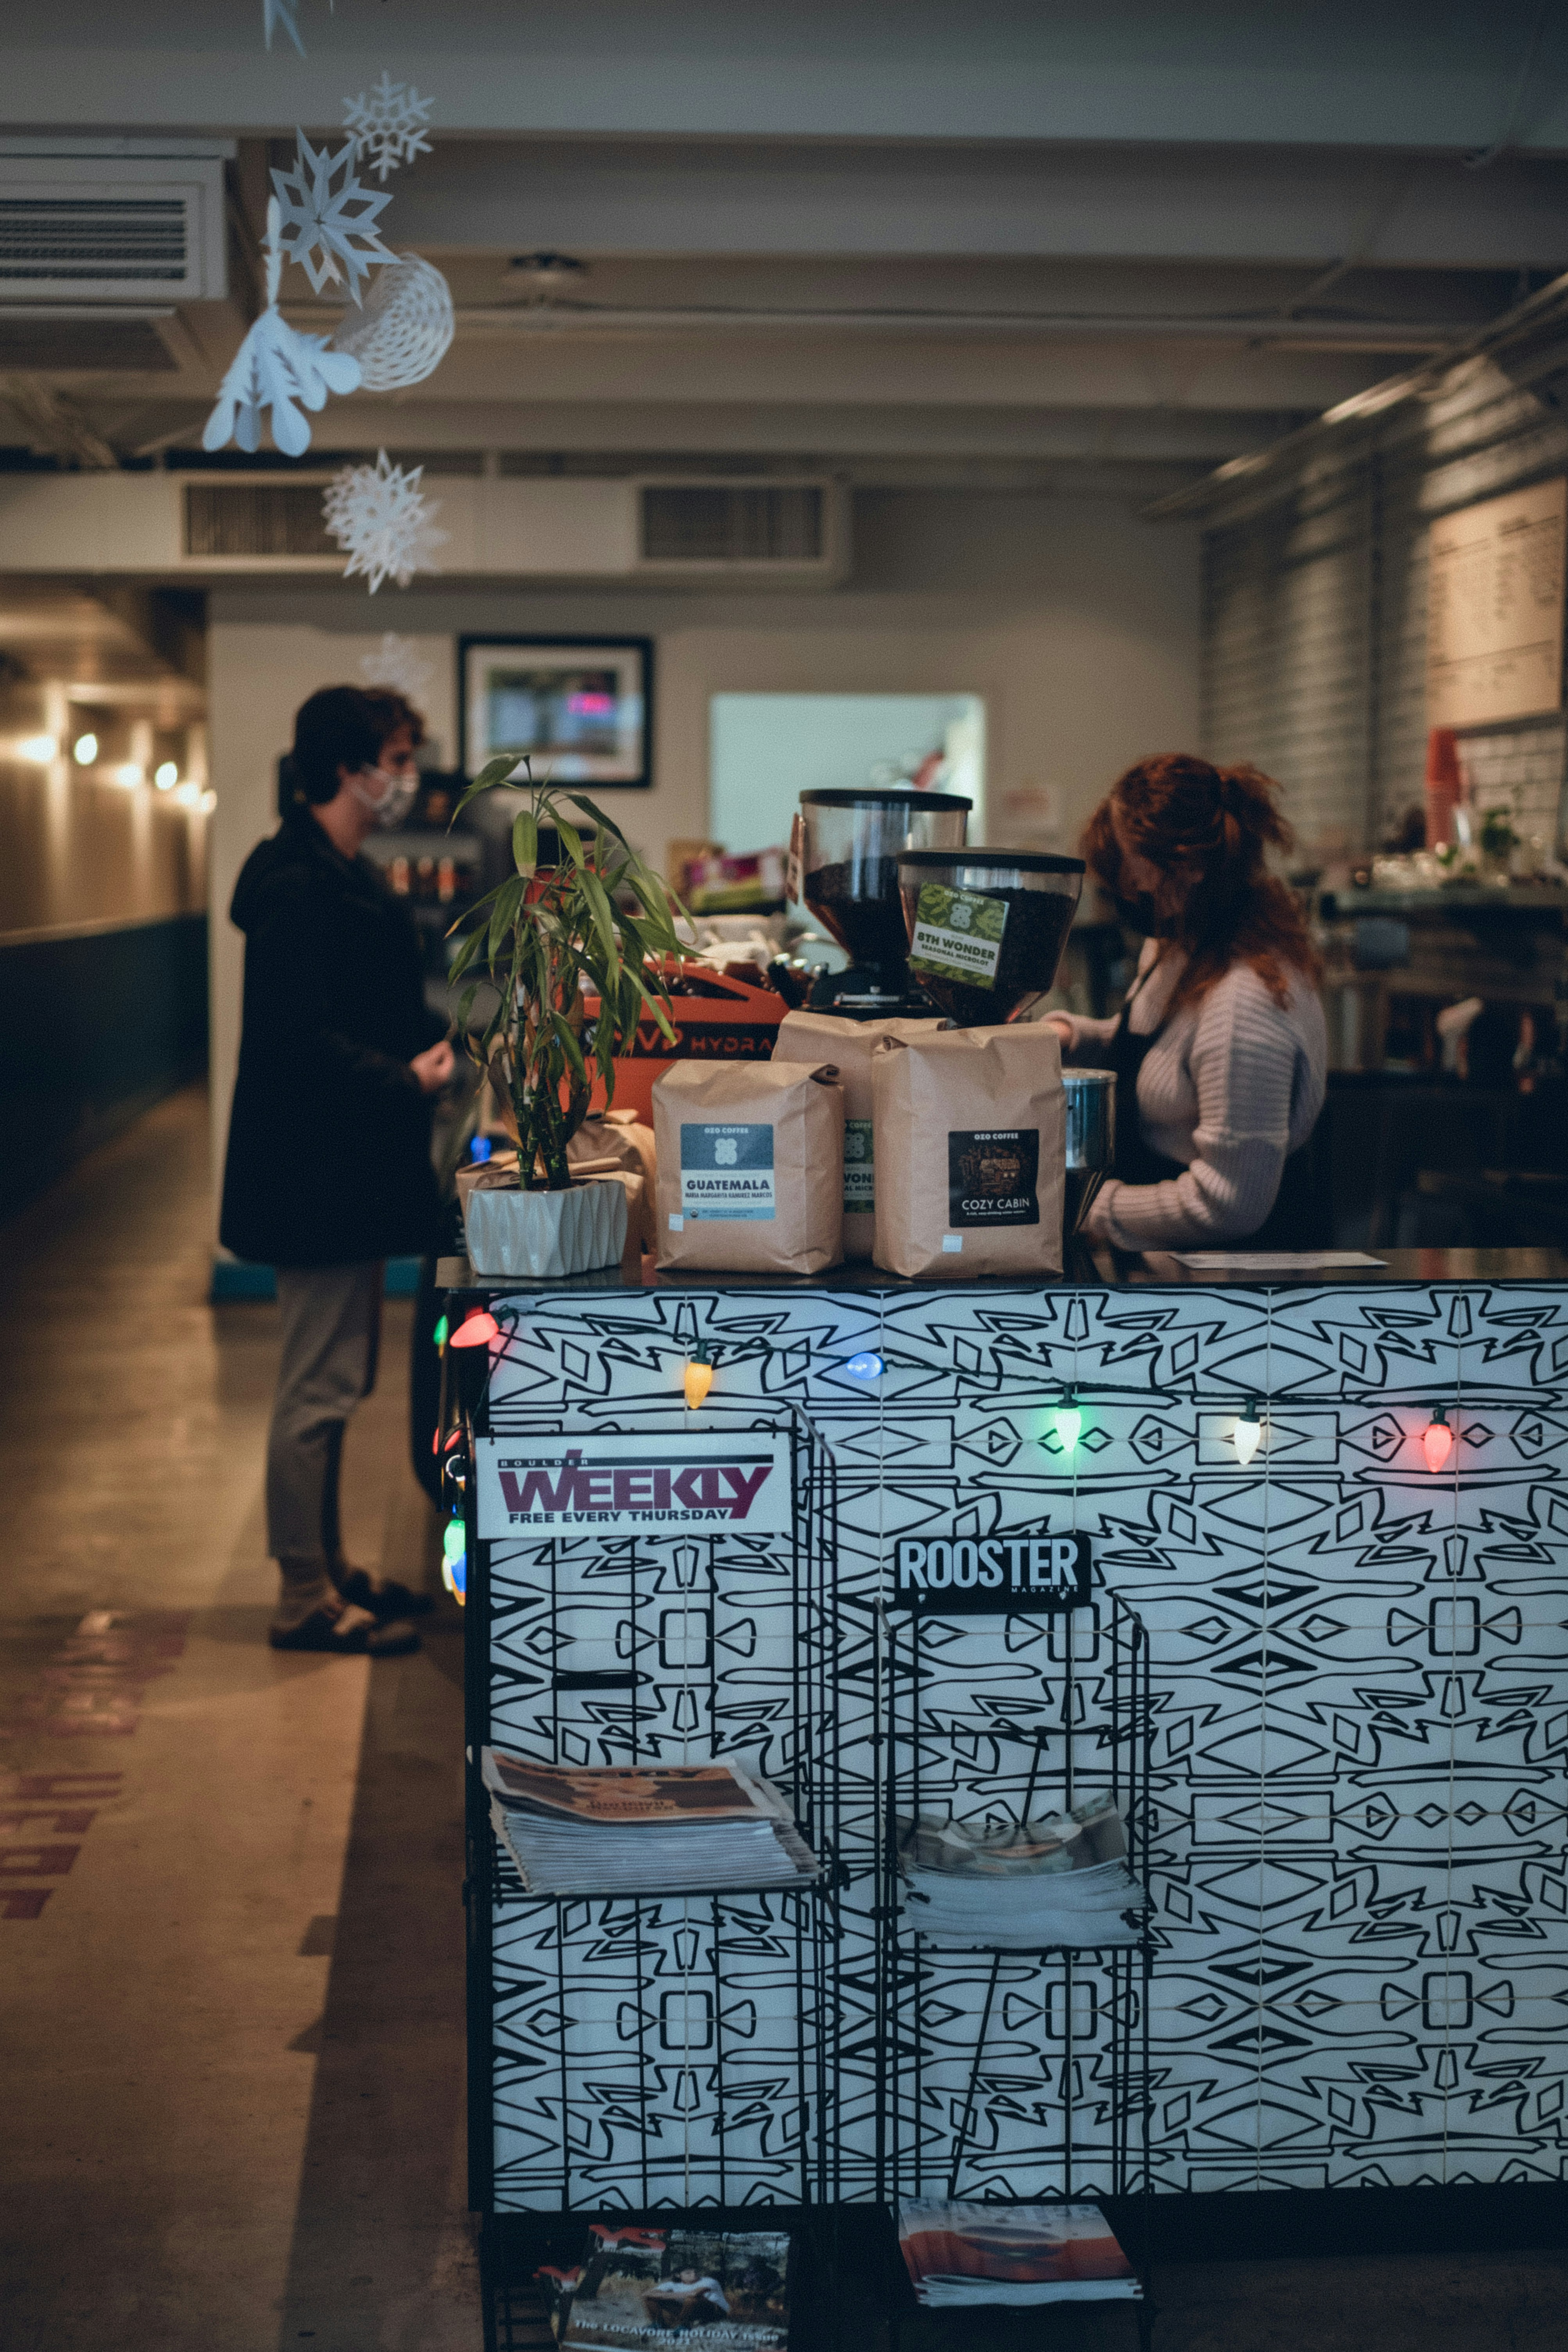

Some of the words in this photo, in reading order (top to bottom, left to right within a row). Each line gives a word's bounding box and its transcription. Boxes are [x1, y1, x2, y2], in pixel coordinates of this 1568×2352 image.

[917, 932, 940, 945] 8TH
[942, 938, 995, 960] WONDER
[921, 944, 954, 958] SEASONAL
[956, 953, 989, 966] MICROLOT
[687, 1180, 770, 1190] GUATEMALA
[962, 1199, 993, 1210] COZY
[997, 1198, 1029, 1209] CABIN
[501, 1459, 589, 1468] BOULDER
[498, 1449, 774, 1519] WEEKLY
[509, 1512, 555, 1524] FREE
[562, 1511, 621, 1523] EVERY
[629, 1509, 728, 1522] THURSDAY
[900, 1538, 1078, 1588] ROOSTER
[575, 2320, 598, 2329] The
[603, 2323, 673, 2338] LOCAVORE
[679, 2329, 738, 2340] HOLIDAY
